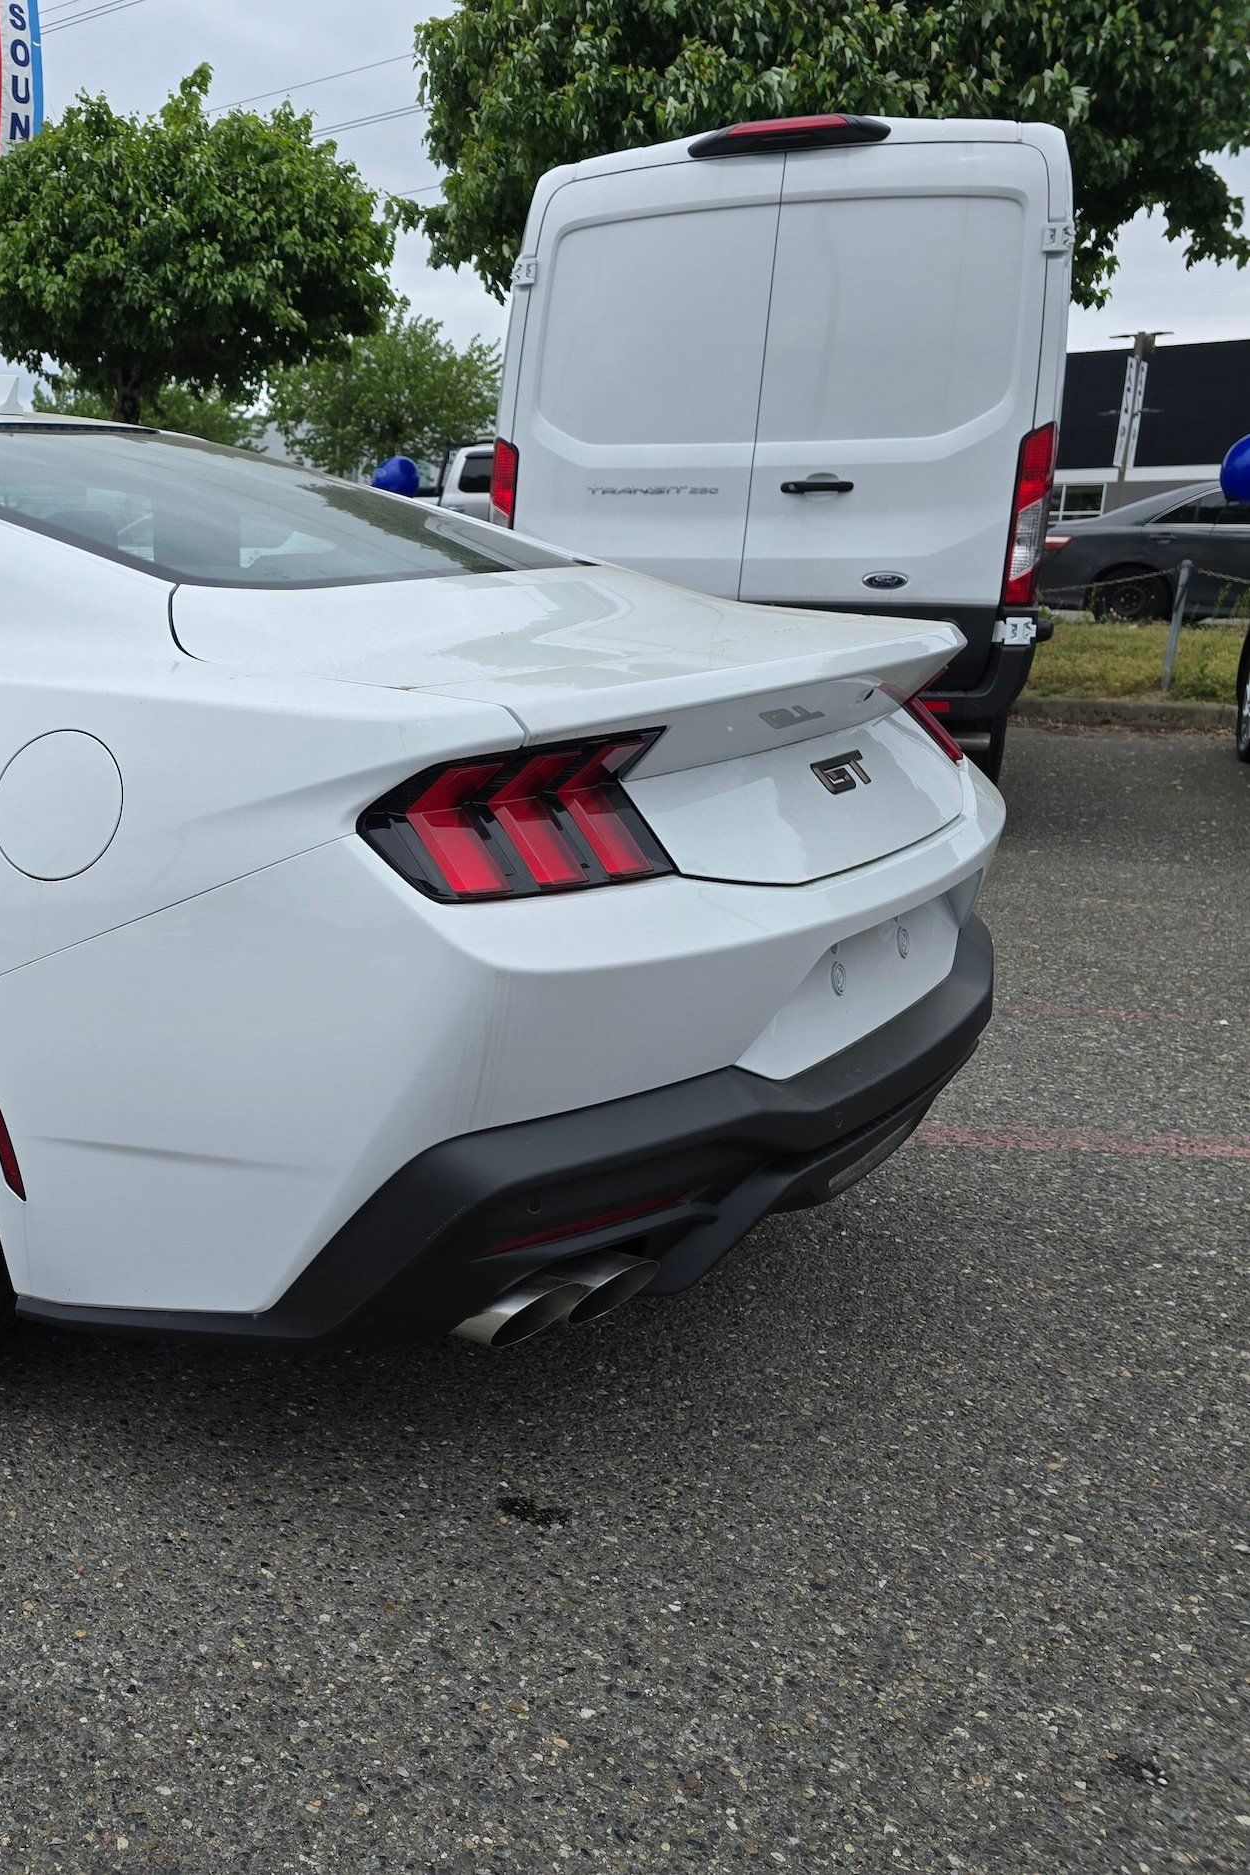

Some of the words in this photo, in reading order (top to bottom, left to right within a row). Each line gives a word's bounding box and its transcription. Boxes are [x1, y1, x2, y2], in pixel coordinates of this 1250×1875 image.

[9, 3, 31, 141] SOUN
[586, 485, 688, 496] TRANSIT
[809, 749, 872, 795] GT
